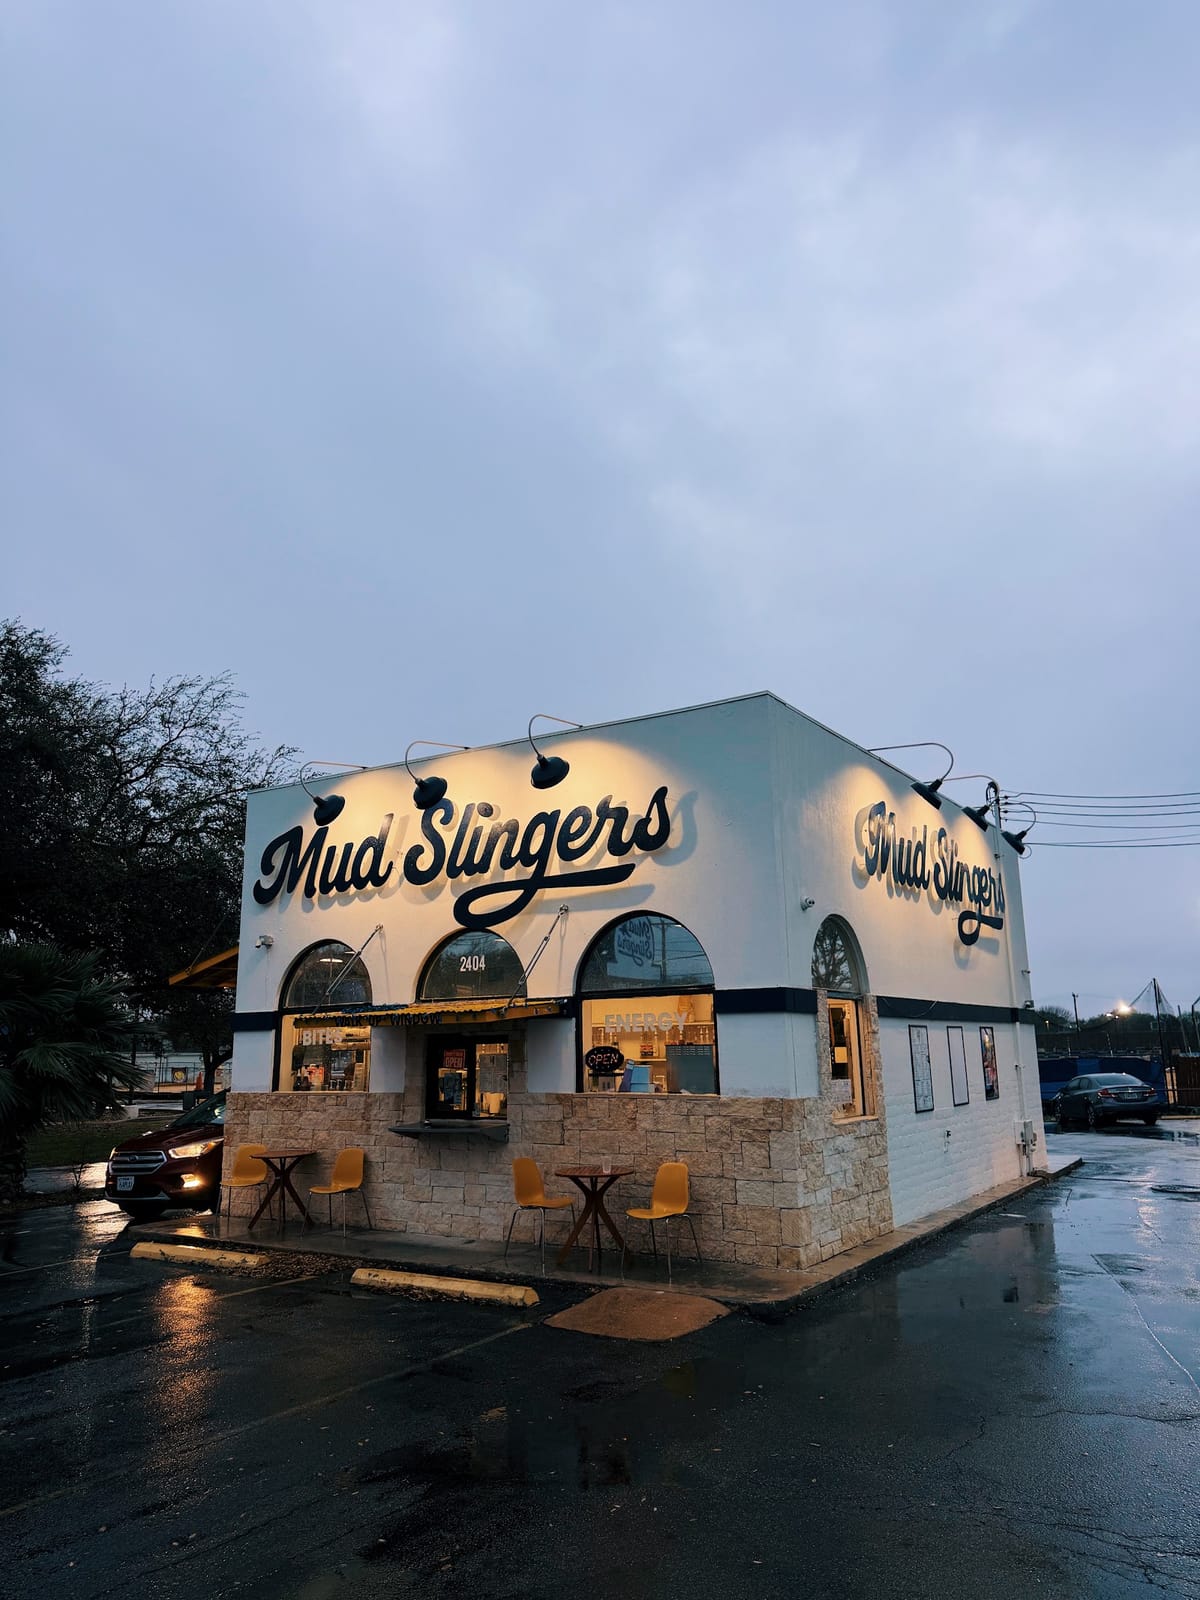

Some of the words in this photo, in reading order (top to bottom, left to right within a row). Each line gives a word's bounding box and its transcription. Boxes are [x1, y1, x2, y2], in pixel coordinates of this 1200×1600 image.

[253, 812, 394, 904] Mud
[403, 786, 671, 929] Slingers
[865, 801, 931, 890] Mud
[933, 827, 1006, 946] Slingers
[460, 955, 486, 972] 2404
[390, 1011, 442, 1027] WINDOW
[604, 1011, 688, 1033] ENERGY
[302, 1028, 342, 1046] BITES
[588, 1052, 619, 1066] OPEN
